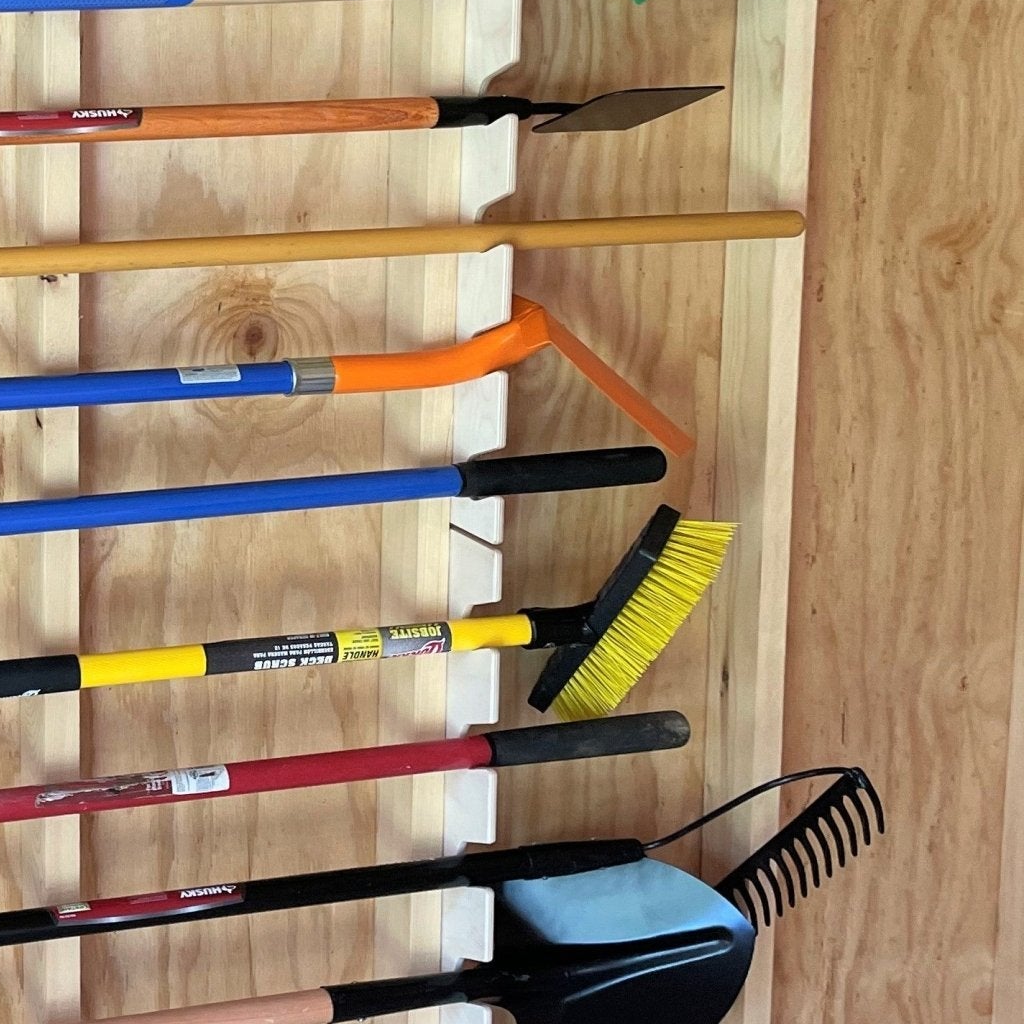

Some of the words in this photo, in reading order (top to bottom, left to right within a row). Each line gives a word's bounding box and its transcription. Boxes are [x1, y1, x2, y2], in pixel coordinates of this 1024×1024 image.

[72, 109, 118, 119] HUSKY
[390, 625, 442, 640] JOBSITE
[343, 649, 380, 660] HANDLE
[254, 658, 297, 670] SCRUB
[300, 655, 334, 667] DECK
[180, 885, 223, 899] HUSKY
